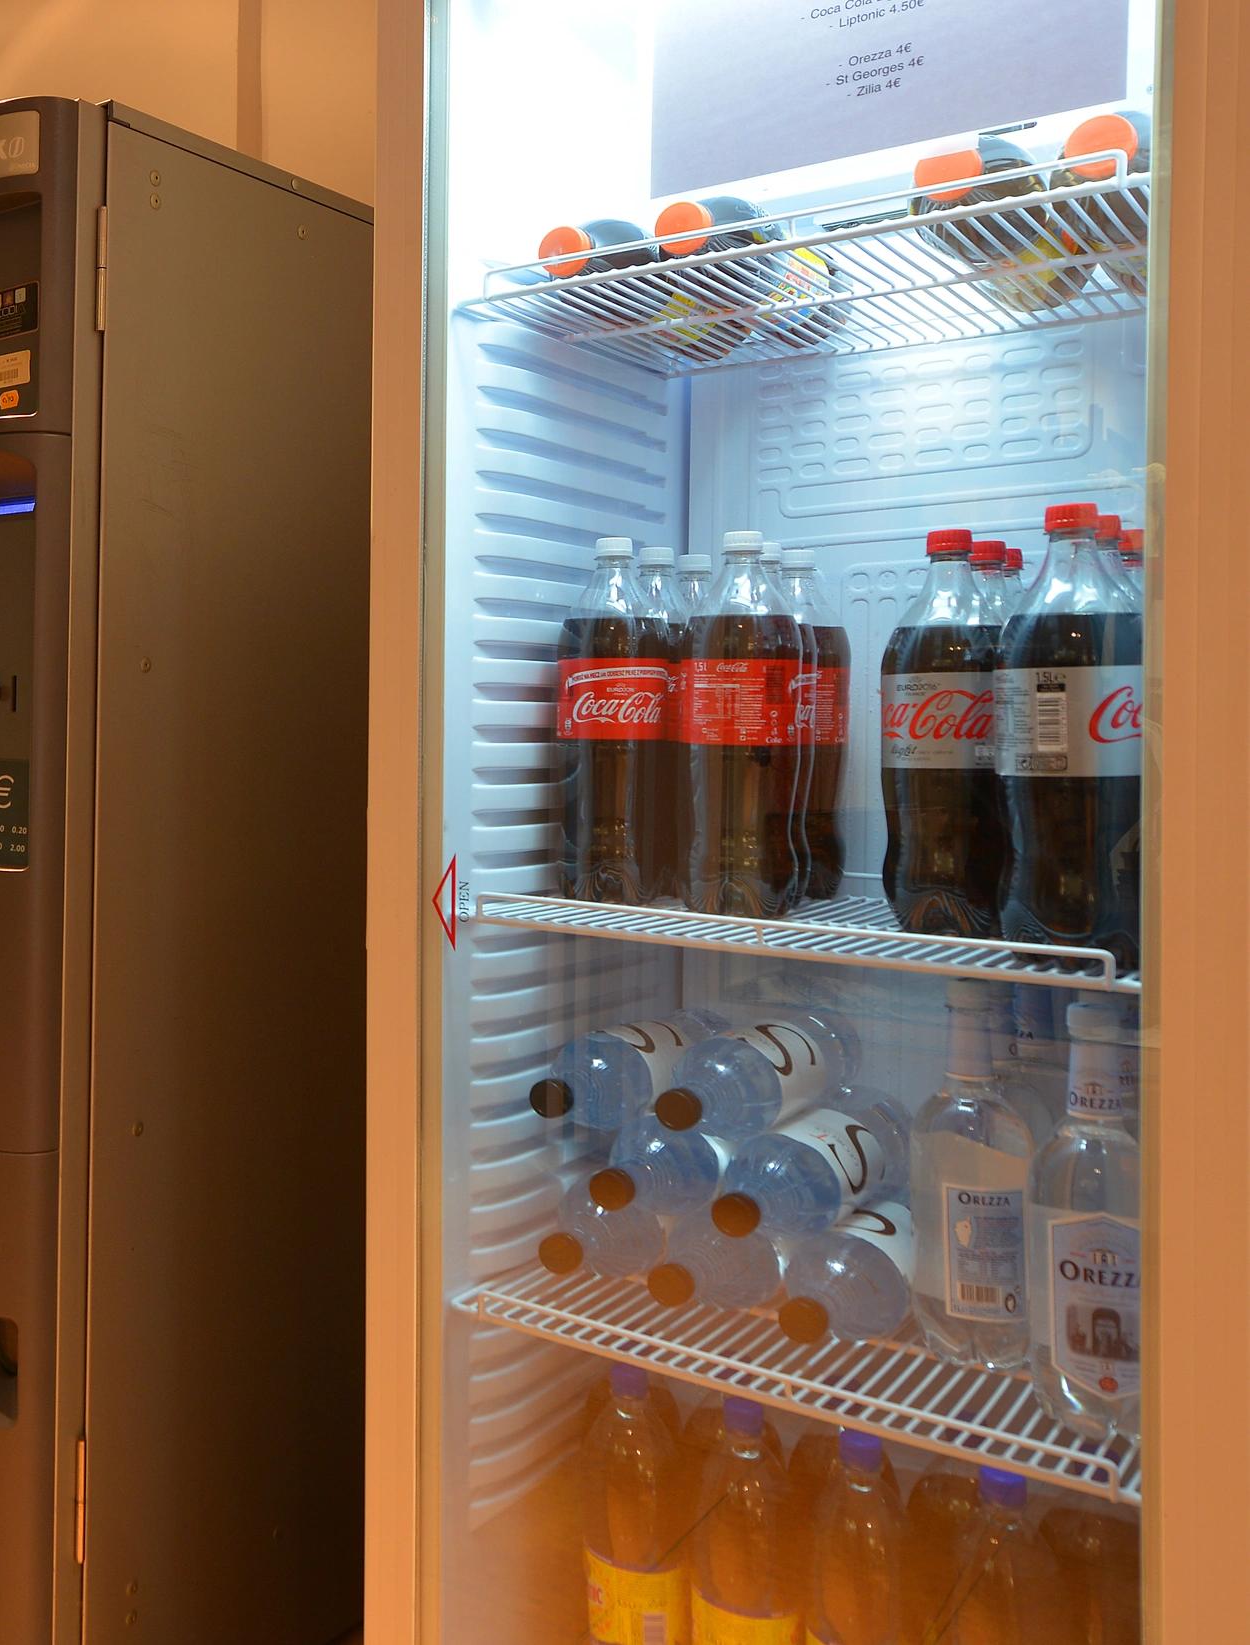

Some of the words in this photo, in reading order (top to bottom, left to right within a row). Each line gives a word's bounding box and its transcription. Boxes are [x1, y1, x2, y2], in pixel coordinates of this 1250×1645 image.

[810, 5, 841, 20] Coca
[839, 8, 886, 28] Liptonic
[889, 0, 925, 14] 4.50€
[848, 50, 892, 67] Orezza
[895, 42, 912, 54] 4€
[835, 75, 849, 86] St
[852, 62, 904, 82] Georges
[908, 56, 925, 67] 4€
[856, 83, 882, 97] Zilia
[885, 77, 902, 89] 4€
[572, 690, 664, 724] Coca-Cola
[11, 825, 28, 835] 0.20
[10, 843, 26, 853] 2.00
[458, 880, 470, 923] OPEN
[1058, 1259, 1141, 1290] OREZZ
